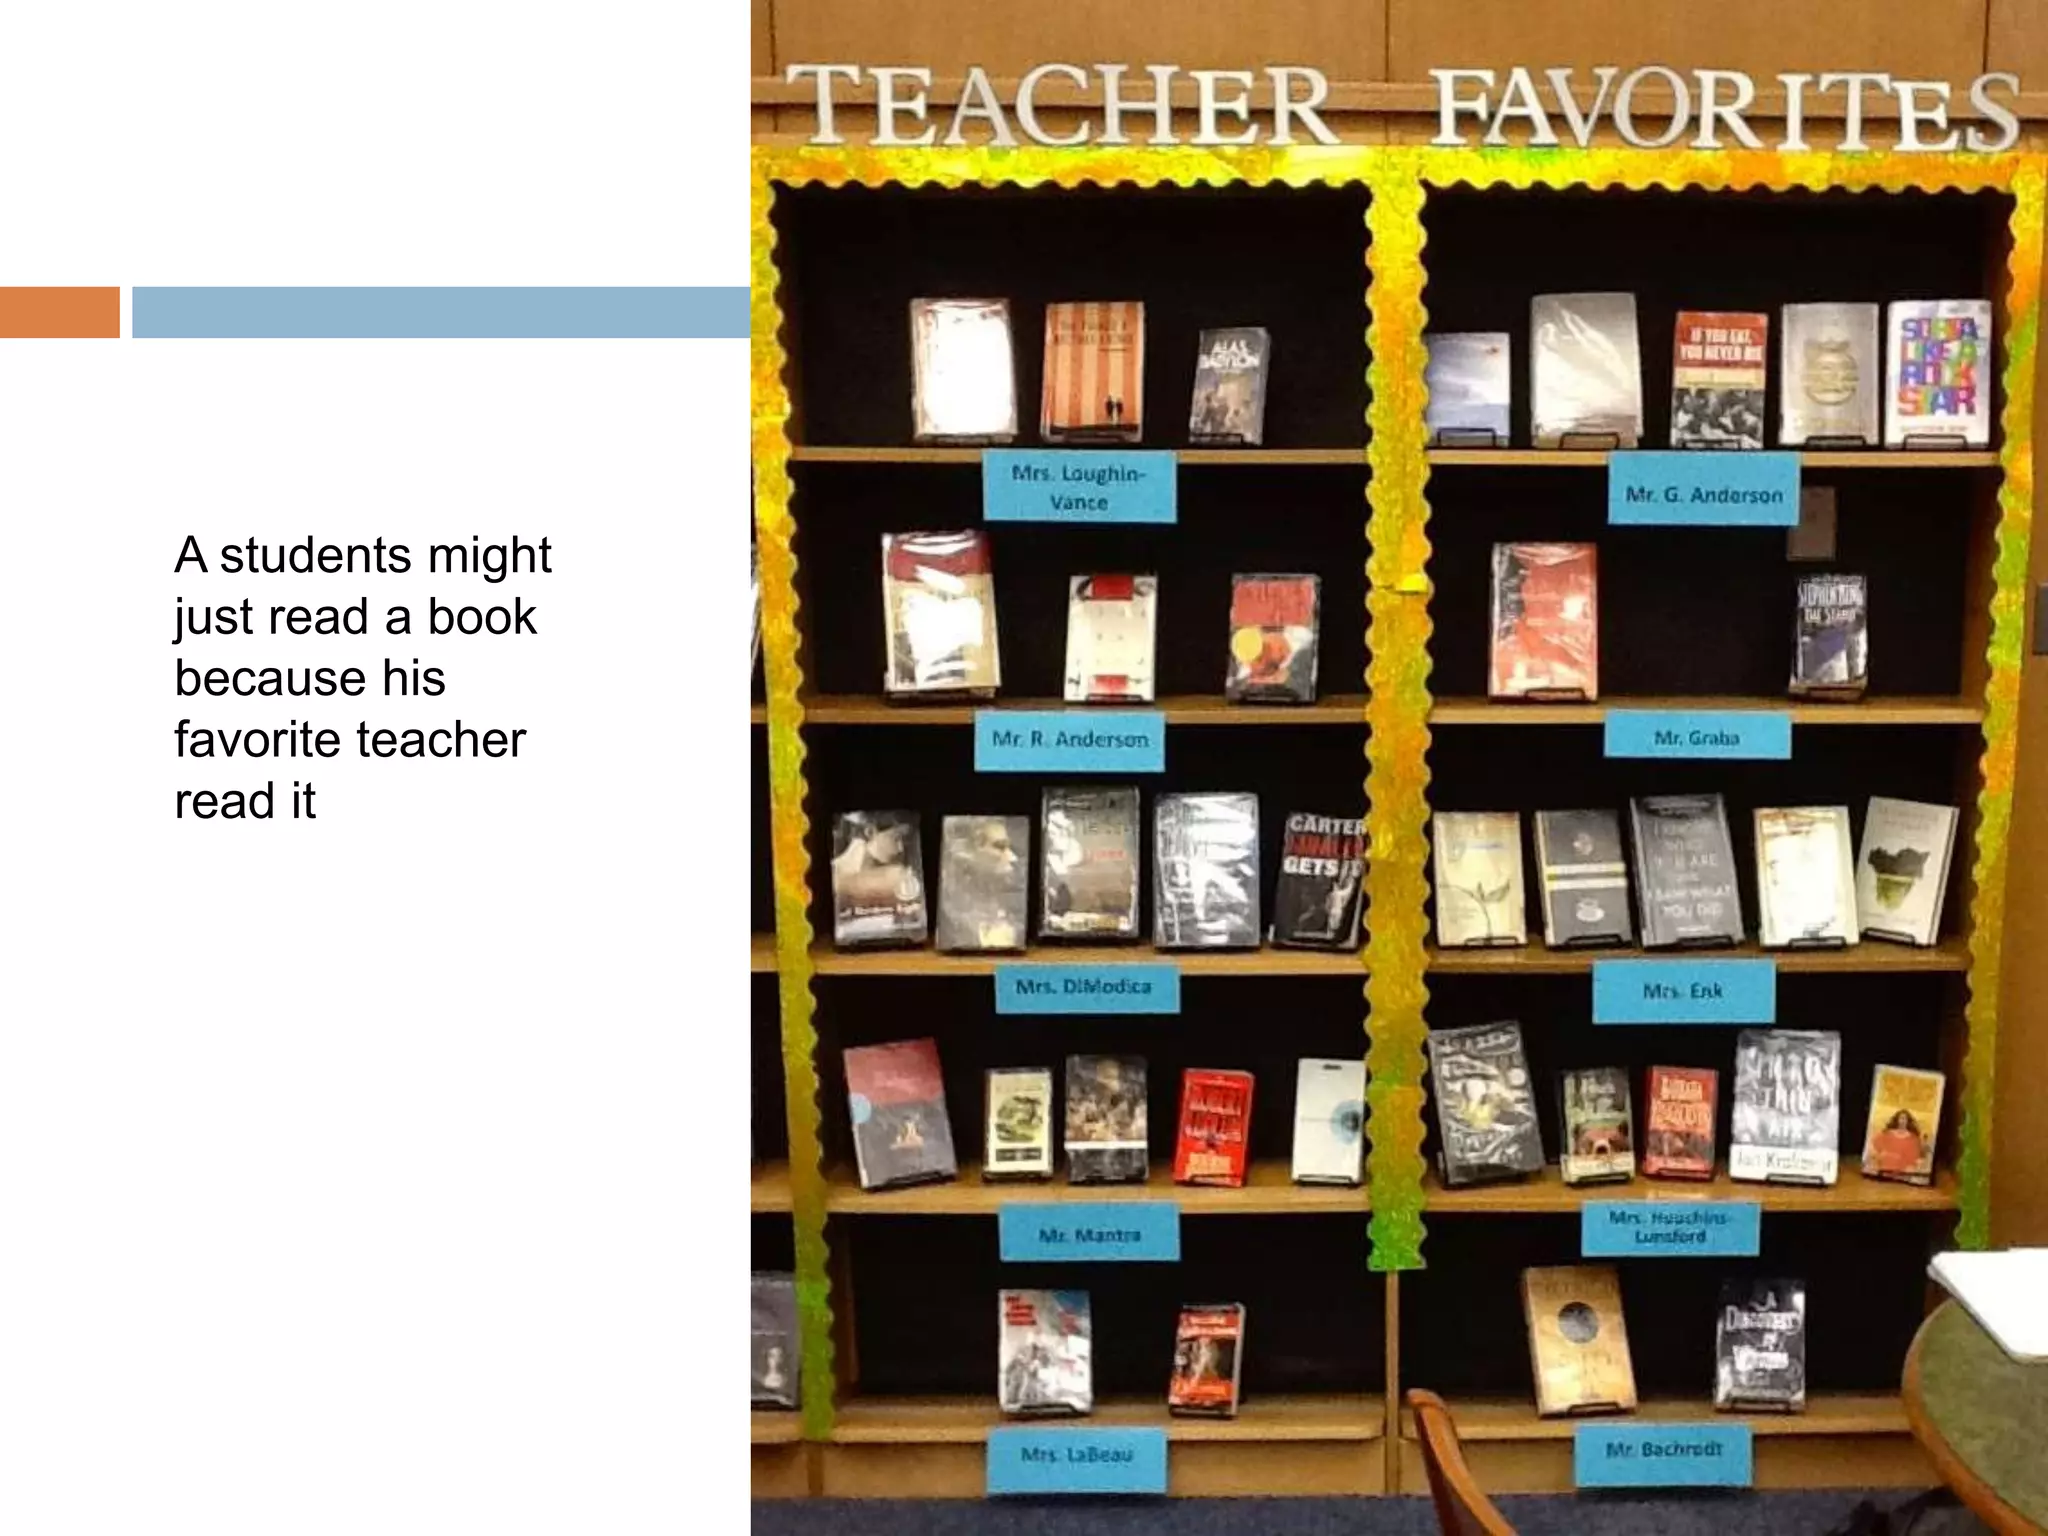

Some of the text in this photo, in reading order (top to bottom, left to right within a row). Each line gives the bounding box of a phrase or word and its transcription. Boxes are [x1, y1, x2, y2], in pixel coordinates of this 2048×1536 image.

[786, 63, 2021, 152] TEACHER FAVORITES
[1898, 387, 1977, 416] STAR
[1012, 463, 1055, 482] Mrs.
[1050, 495, 1109, 511] Vance
[1625, 486, 1784, 504] Mr. G. Anderson
[992, 730, 1024, 748] Mr.
[1055, 730, 1150, 748] Anderson
[1654, 729, 1741, 747] Mr. Graba
[1290, 814, 1367, 834] CARTER
[1283, 855, 1339, 877] GETS
[1016, 979, 1152, 995] Mrs. DiModica
[1643, 983, 1723, 999] Mrs. Enk
[1609, 1210, 1647, 1225] Mrs.
[1038, 1228, 1142, 1244] Mr. Mantra
[1635, 1229, 1707, 1245] Lunsford
[1021, 1447, 1134, 1463] Mrs. LaBeau
[1606, 1443, 1638, 1458] Mr.
